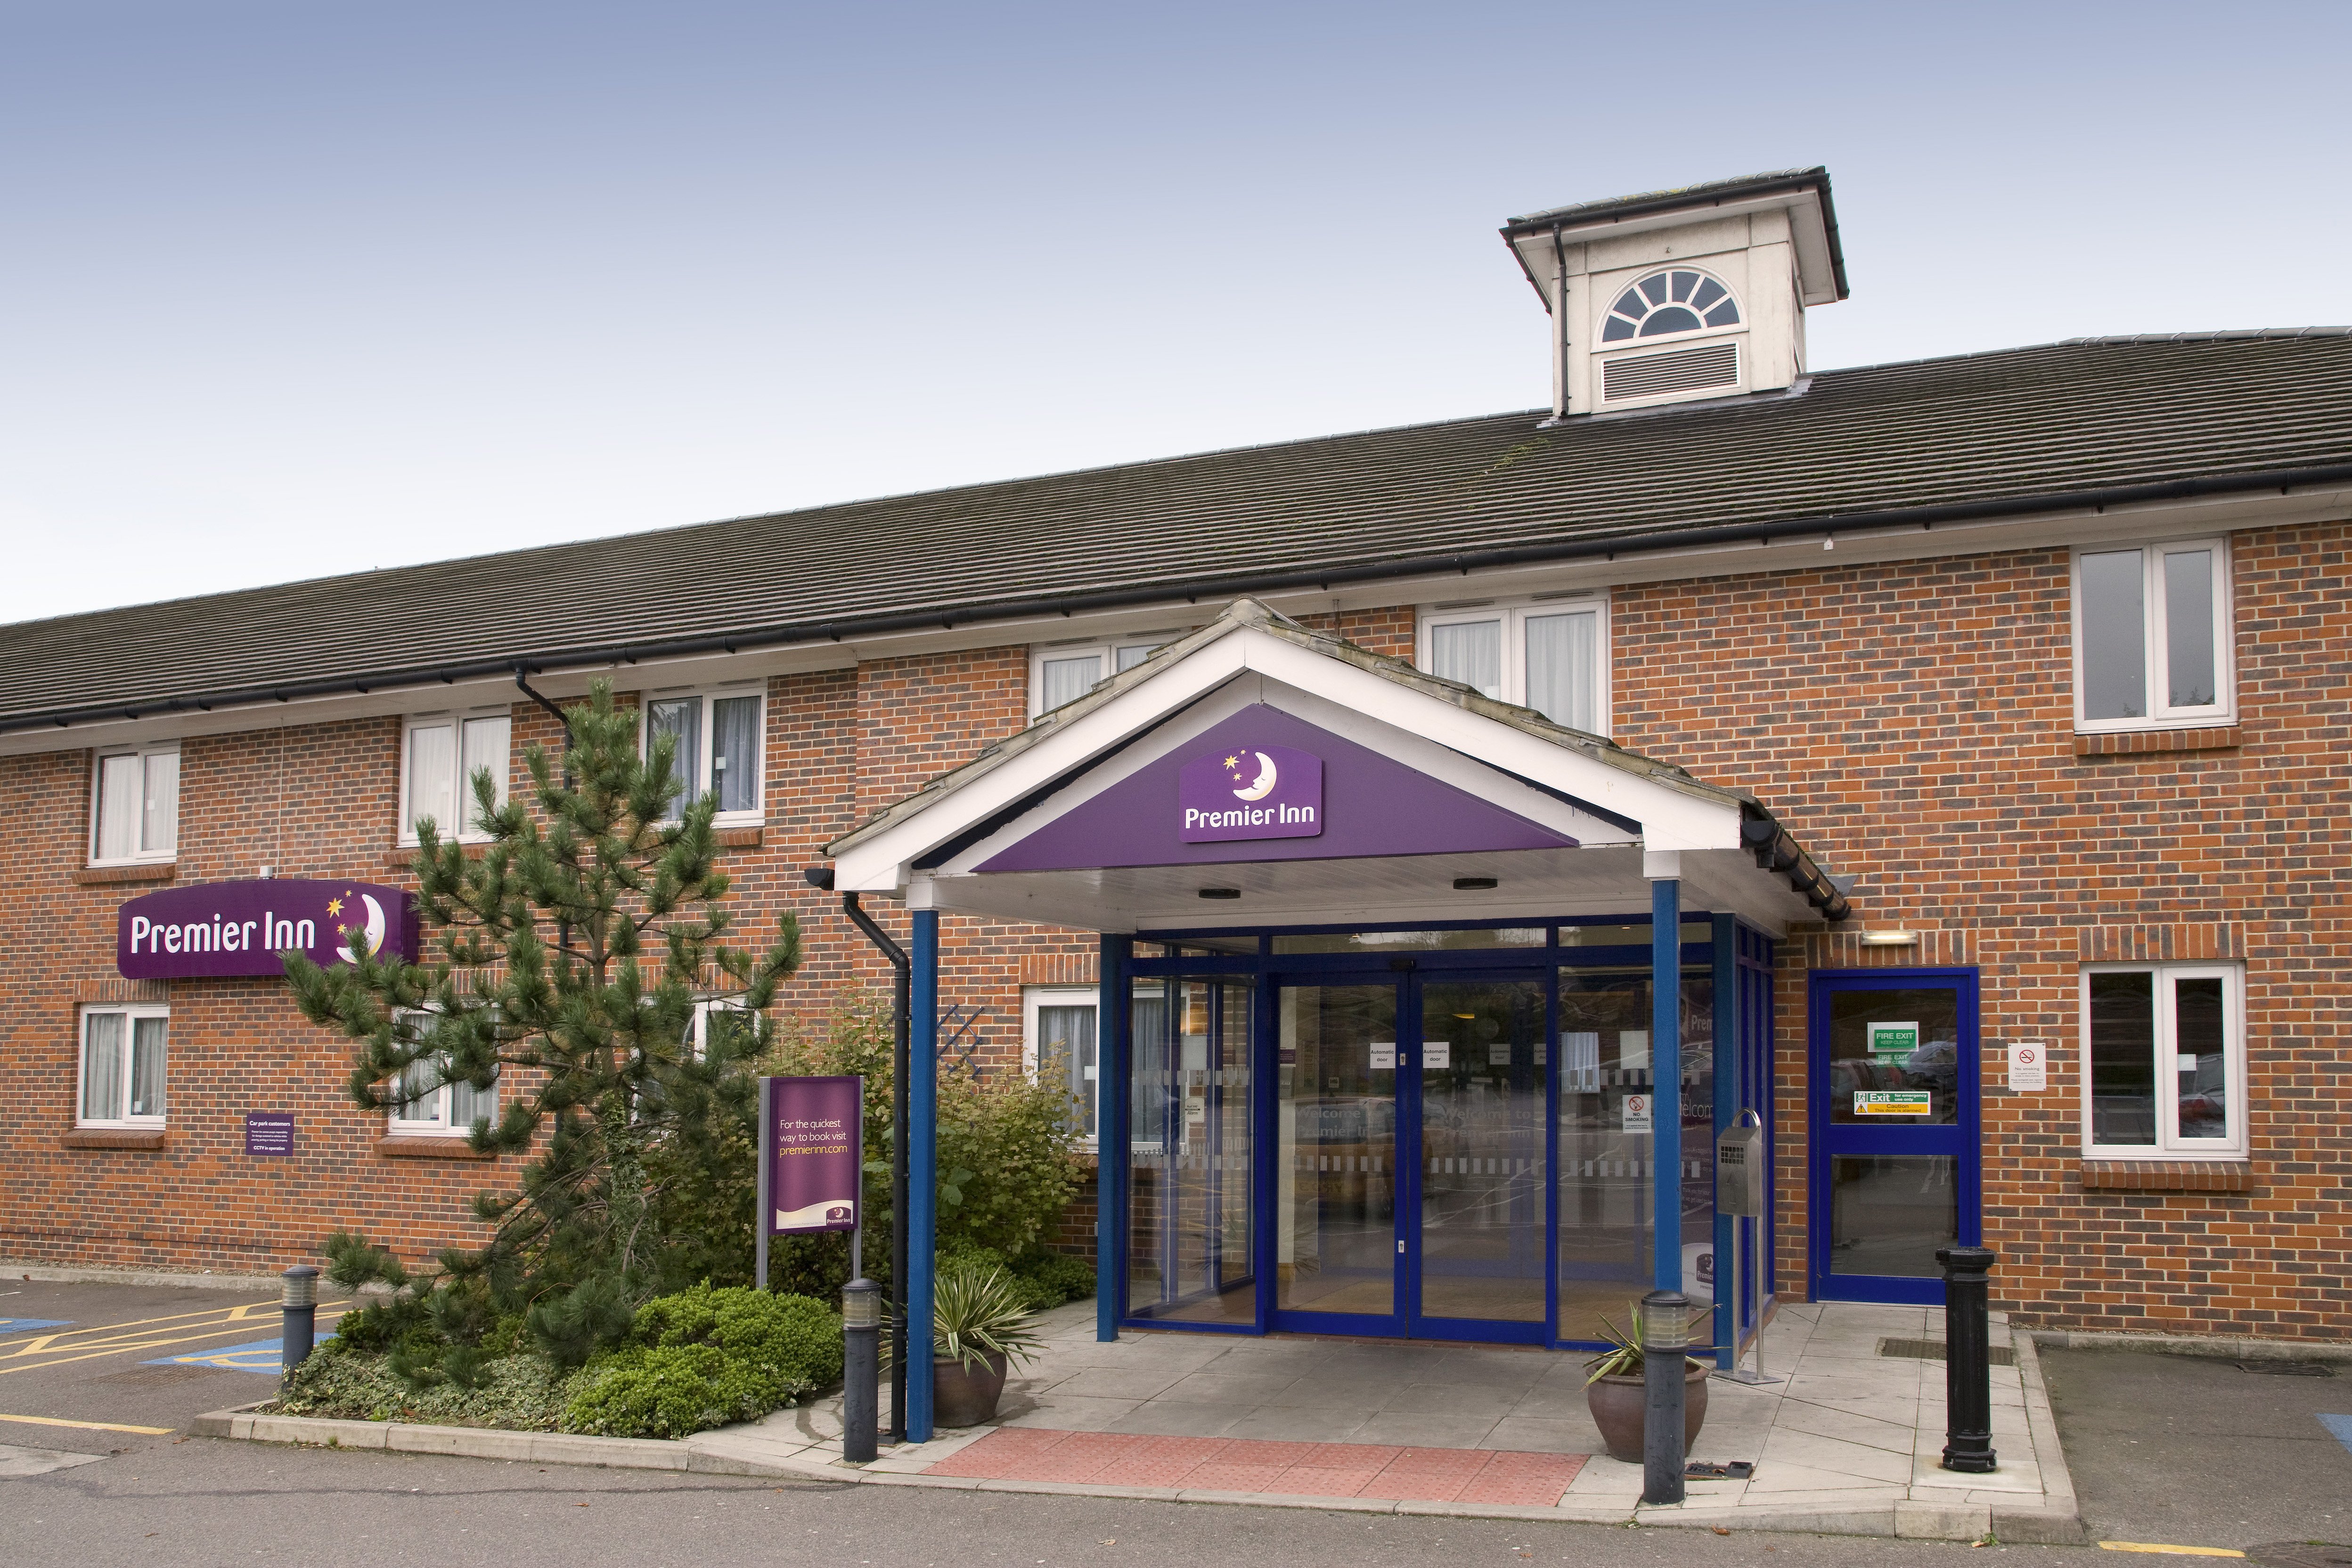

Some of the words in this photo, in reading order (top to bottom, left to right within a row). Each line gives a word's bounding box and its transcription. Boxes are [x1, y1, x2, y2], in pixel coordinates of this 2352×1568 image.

[1185, 805, 1275, 829] Premier
[1280, 803, 1314, 824] Inn
[131, 913, 257, 954] Premier
[265, 911, 315, 950] Inn
[1870, 1094, 1890, 1102] Exit
[780, 1120, 794, 1129] For
[796, 1119, 808, 1128] the
[810, 1119, 841, 1130] quickest
[780, 1135, 796, 1144] way
[799, 1133, 808, 1141] to
[809, 1131, 830, 1141] book
[832, 1131, 847, 1140] visit
[780, 1144, 848, 1158] premierinn.com
